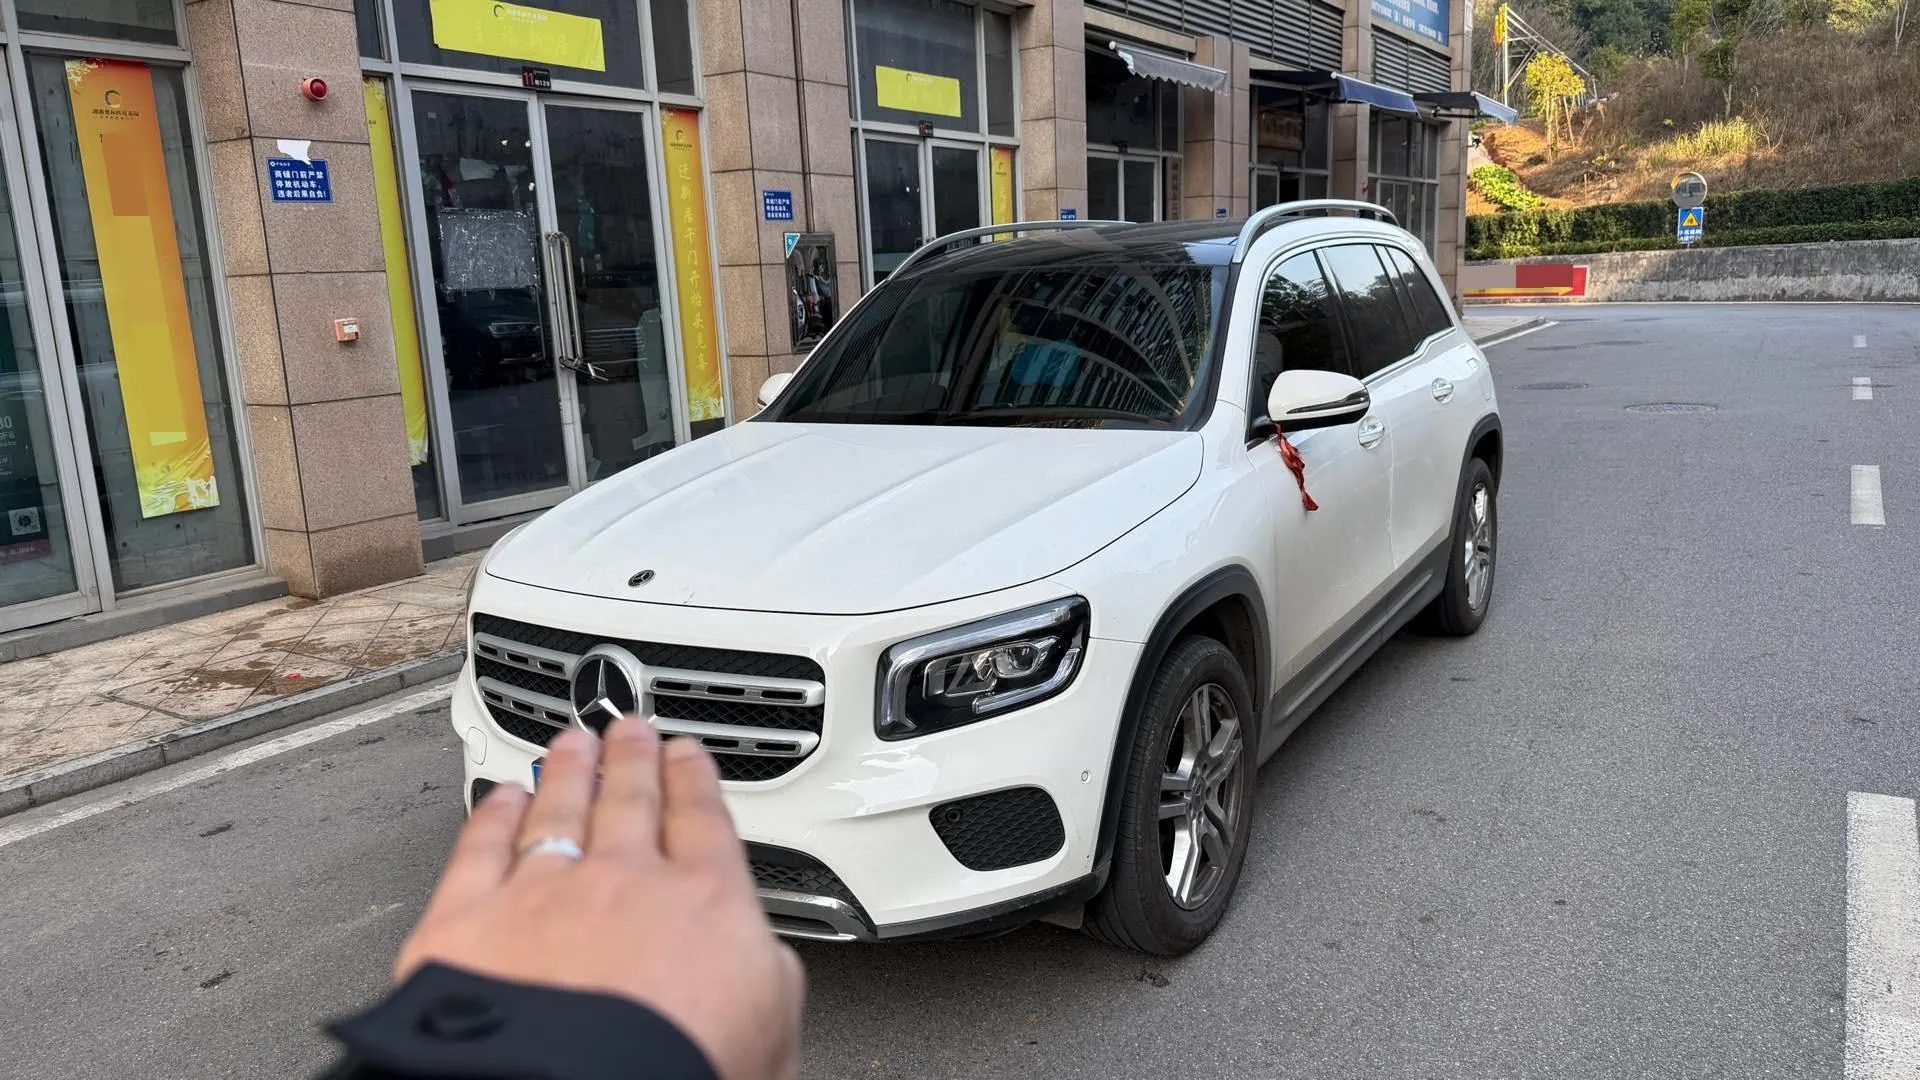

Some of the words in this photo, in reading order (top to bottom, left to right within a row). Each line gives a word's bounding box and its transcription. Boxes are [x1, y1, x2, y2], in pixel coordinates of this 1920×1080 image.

[274, 170, 324, 180] 商铺门前严禁
